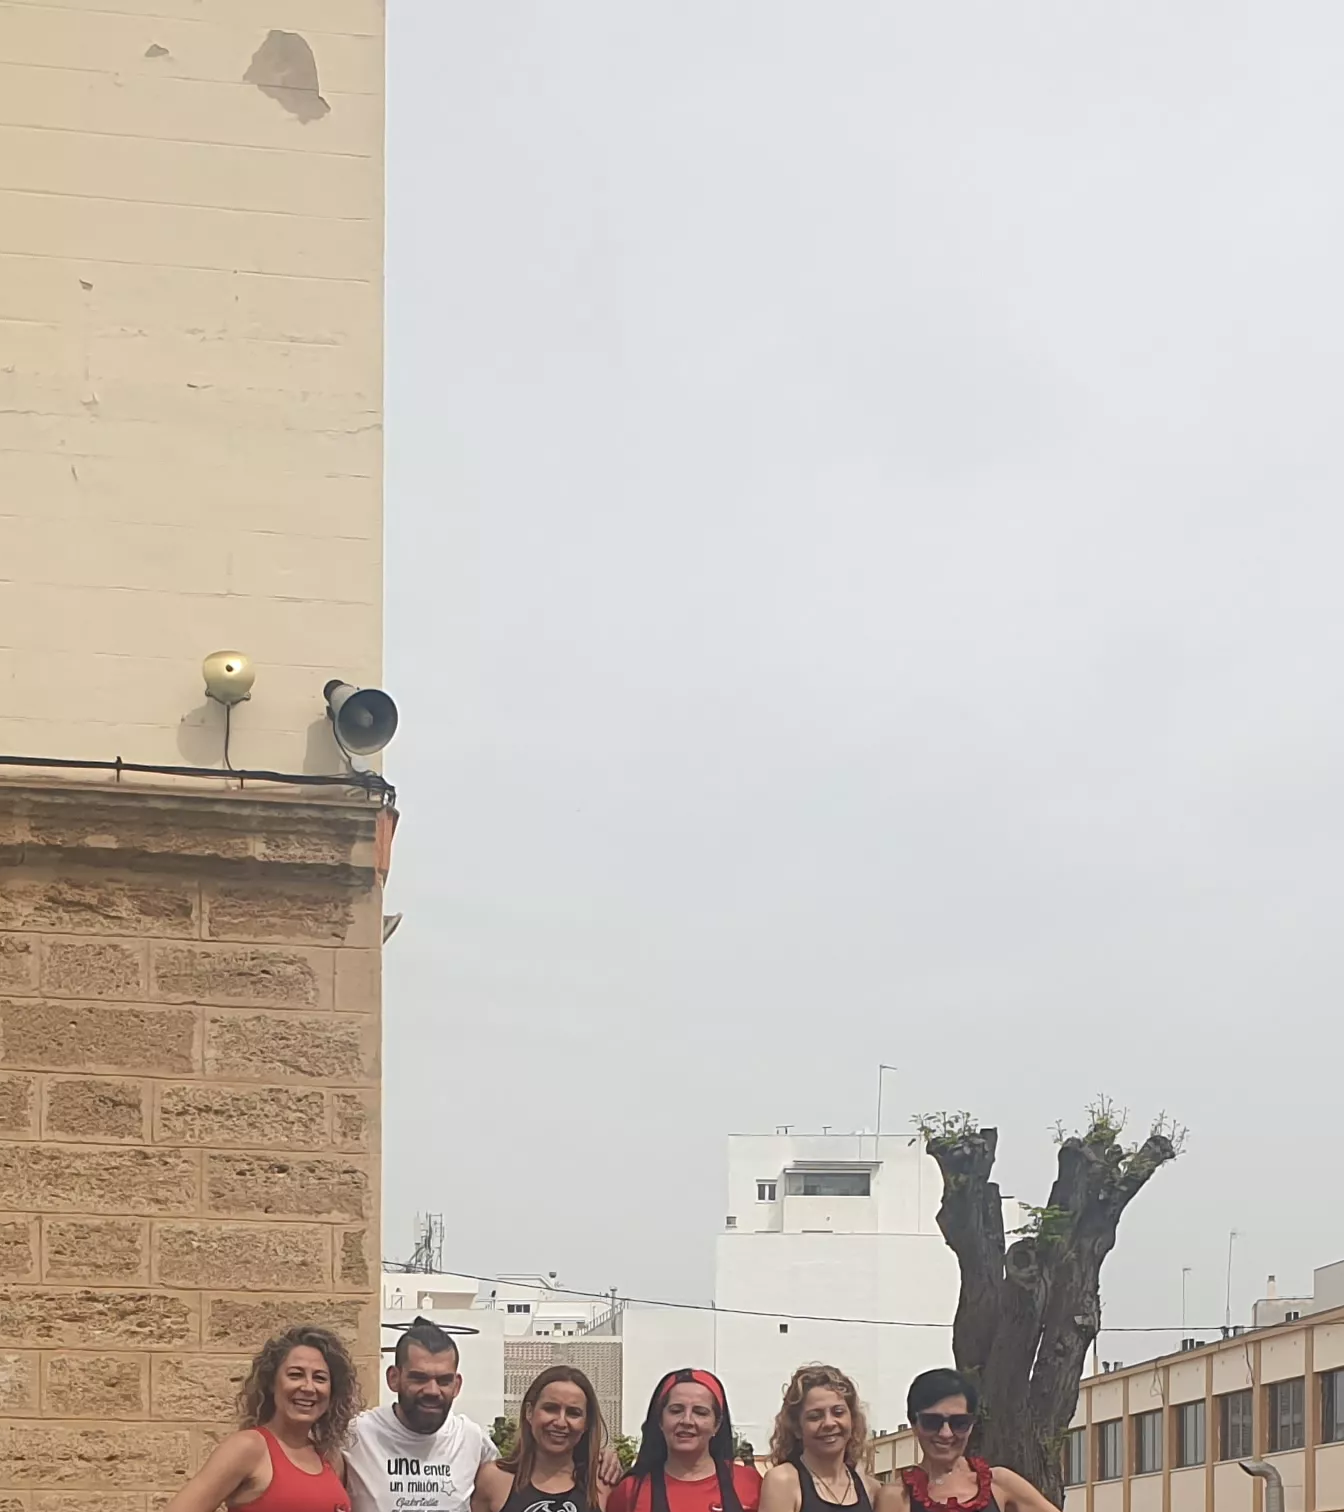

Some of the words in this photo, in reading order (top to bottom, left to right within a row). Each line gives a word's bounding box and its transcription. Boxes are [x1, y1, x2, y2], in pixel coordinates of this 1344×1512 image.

[387, 1457, 421, 1476] una
[423, 1464, 451, 1477] entre
[390, 1481, 404, 1492] un
